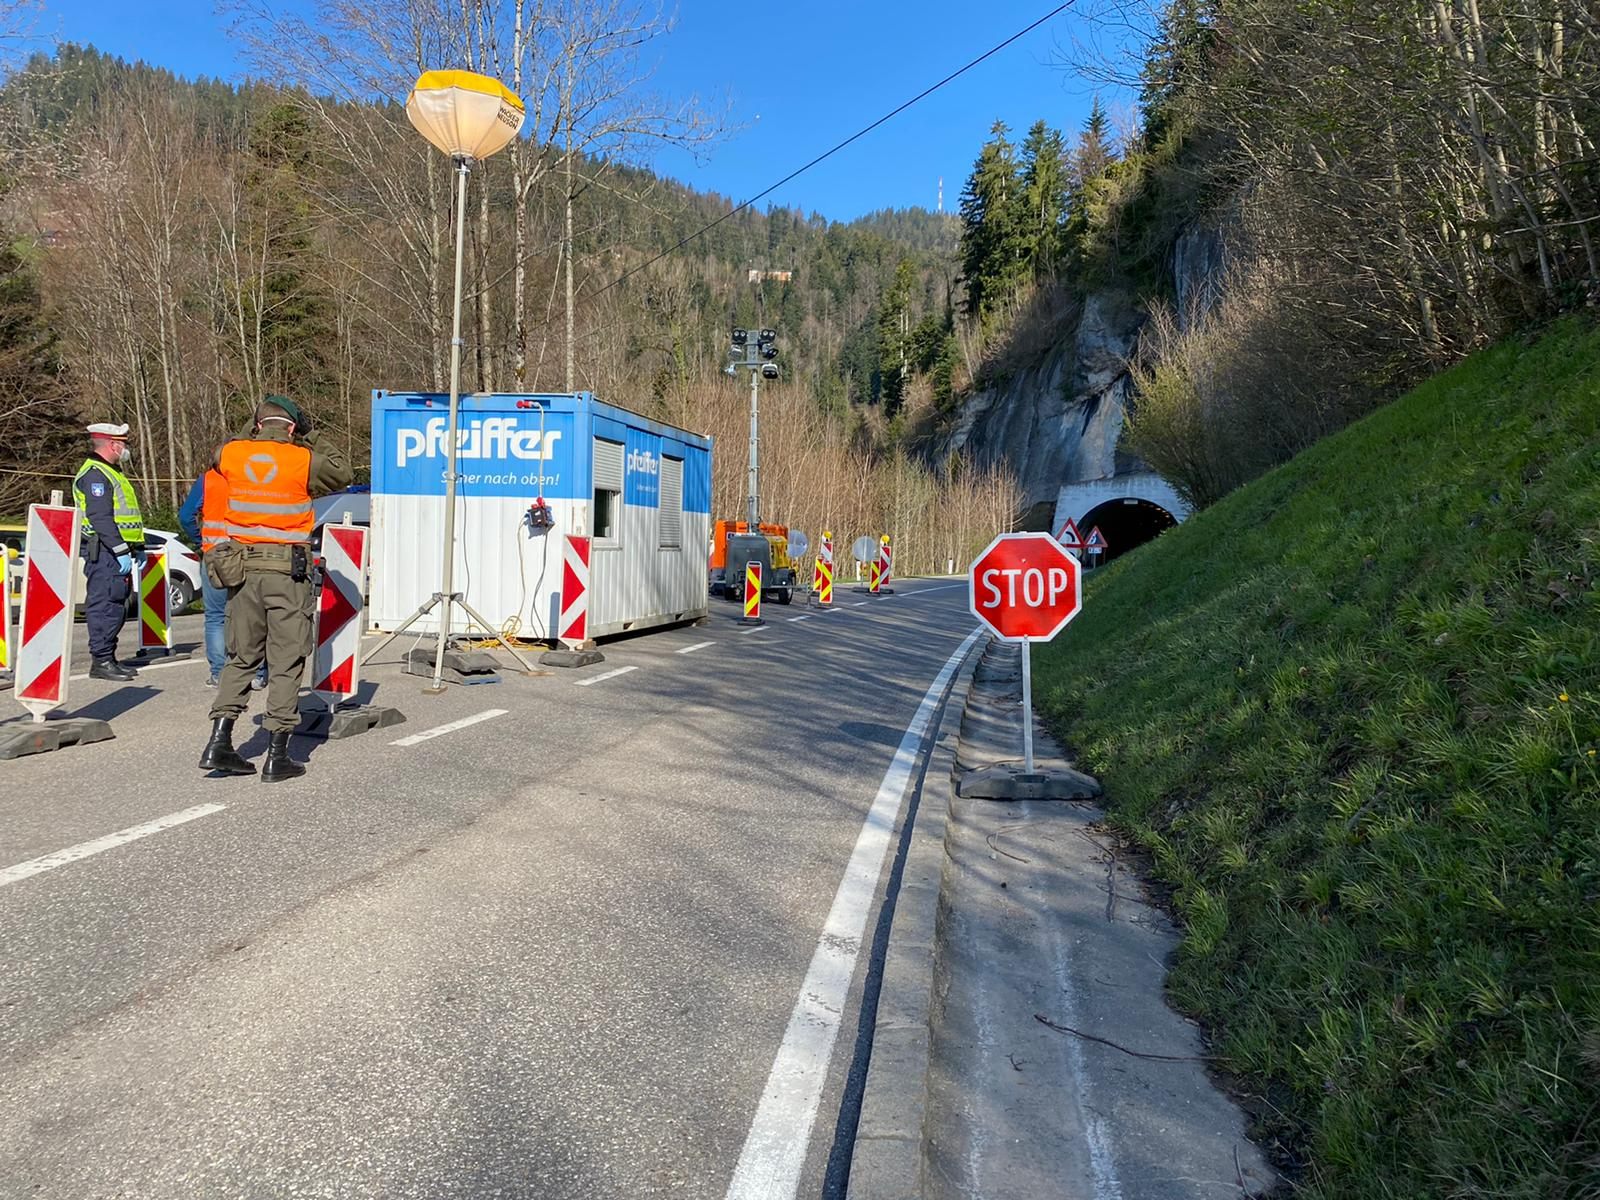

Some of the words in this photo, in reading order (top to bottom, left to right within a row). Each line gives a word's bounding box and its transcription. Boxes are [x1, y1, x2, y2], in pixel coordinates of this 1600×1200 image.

[397, 417, 561, 467] pfeiffer
[484, 472, 517, 485] nach
[982, 568, 1068, 608] STOP
